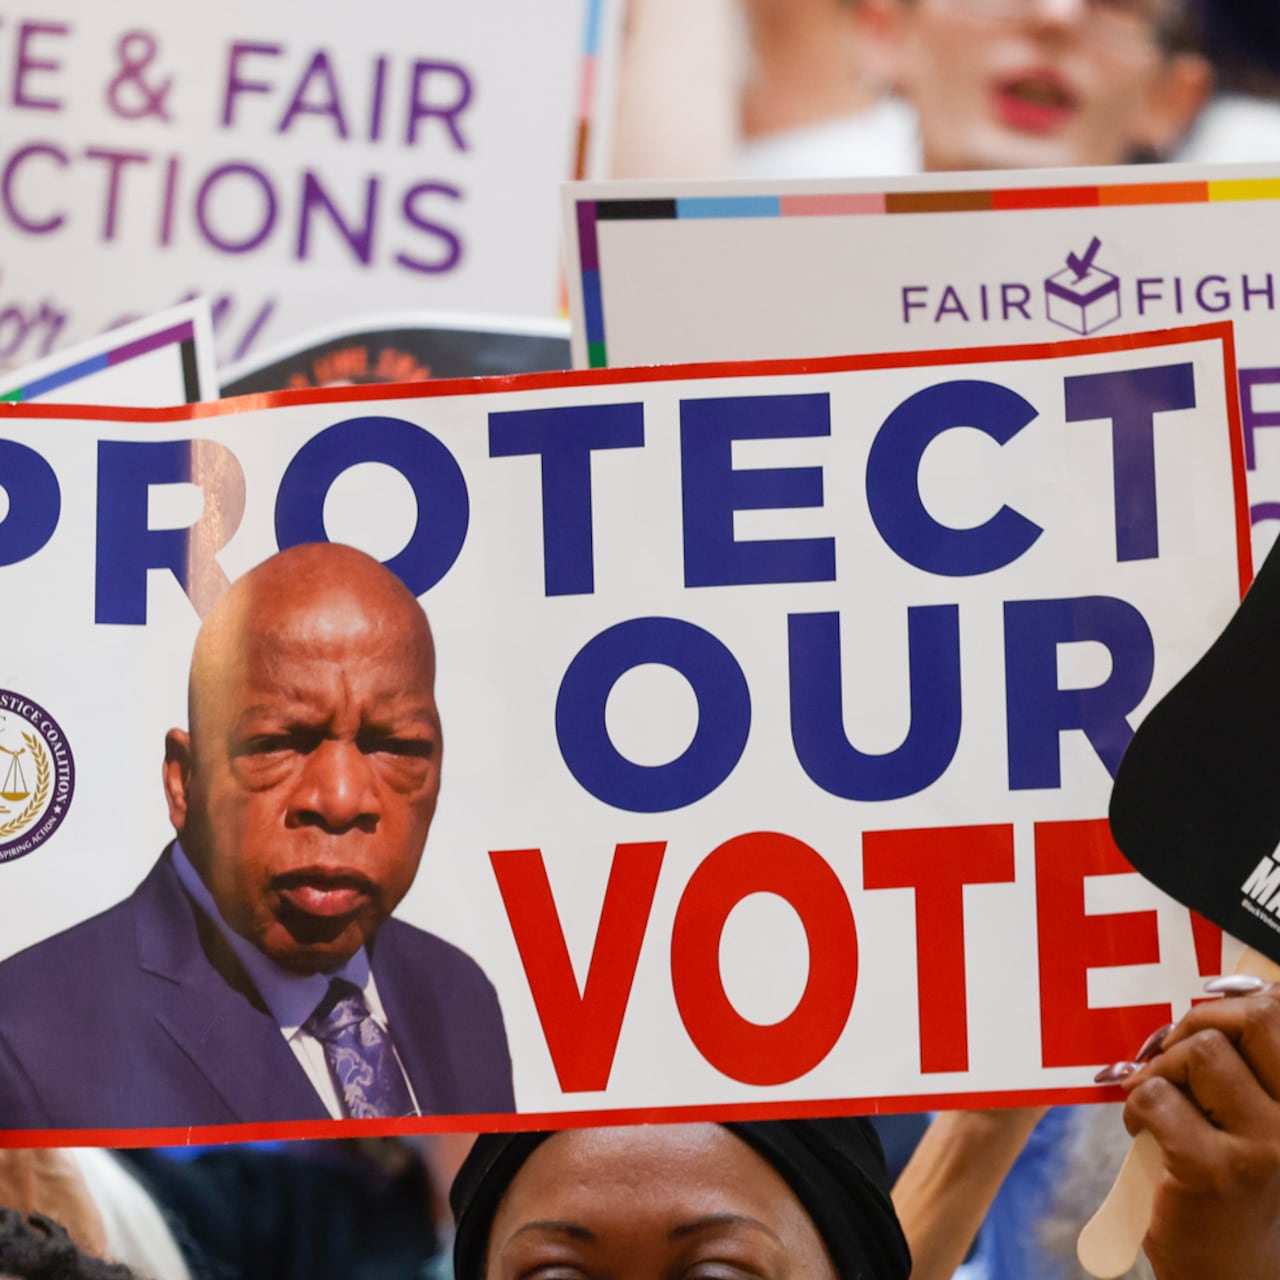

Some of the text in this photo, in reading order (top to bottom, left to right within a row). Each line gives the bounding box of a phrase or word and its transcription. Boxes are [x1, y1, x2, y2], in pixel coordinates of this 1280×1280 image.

[103, 29, 176, 124] &
[219, 40, 478, 153] FAIR
[900, 282, 1034, 325] FAIR
[554, 595, 1156, 814] OUR
[40, 720, 71, 804] COALITION
